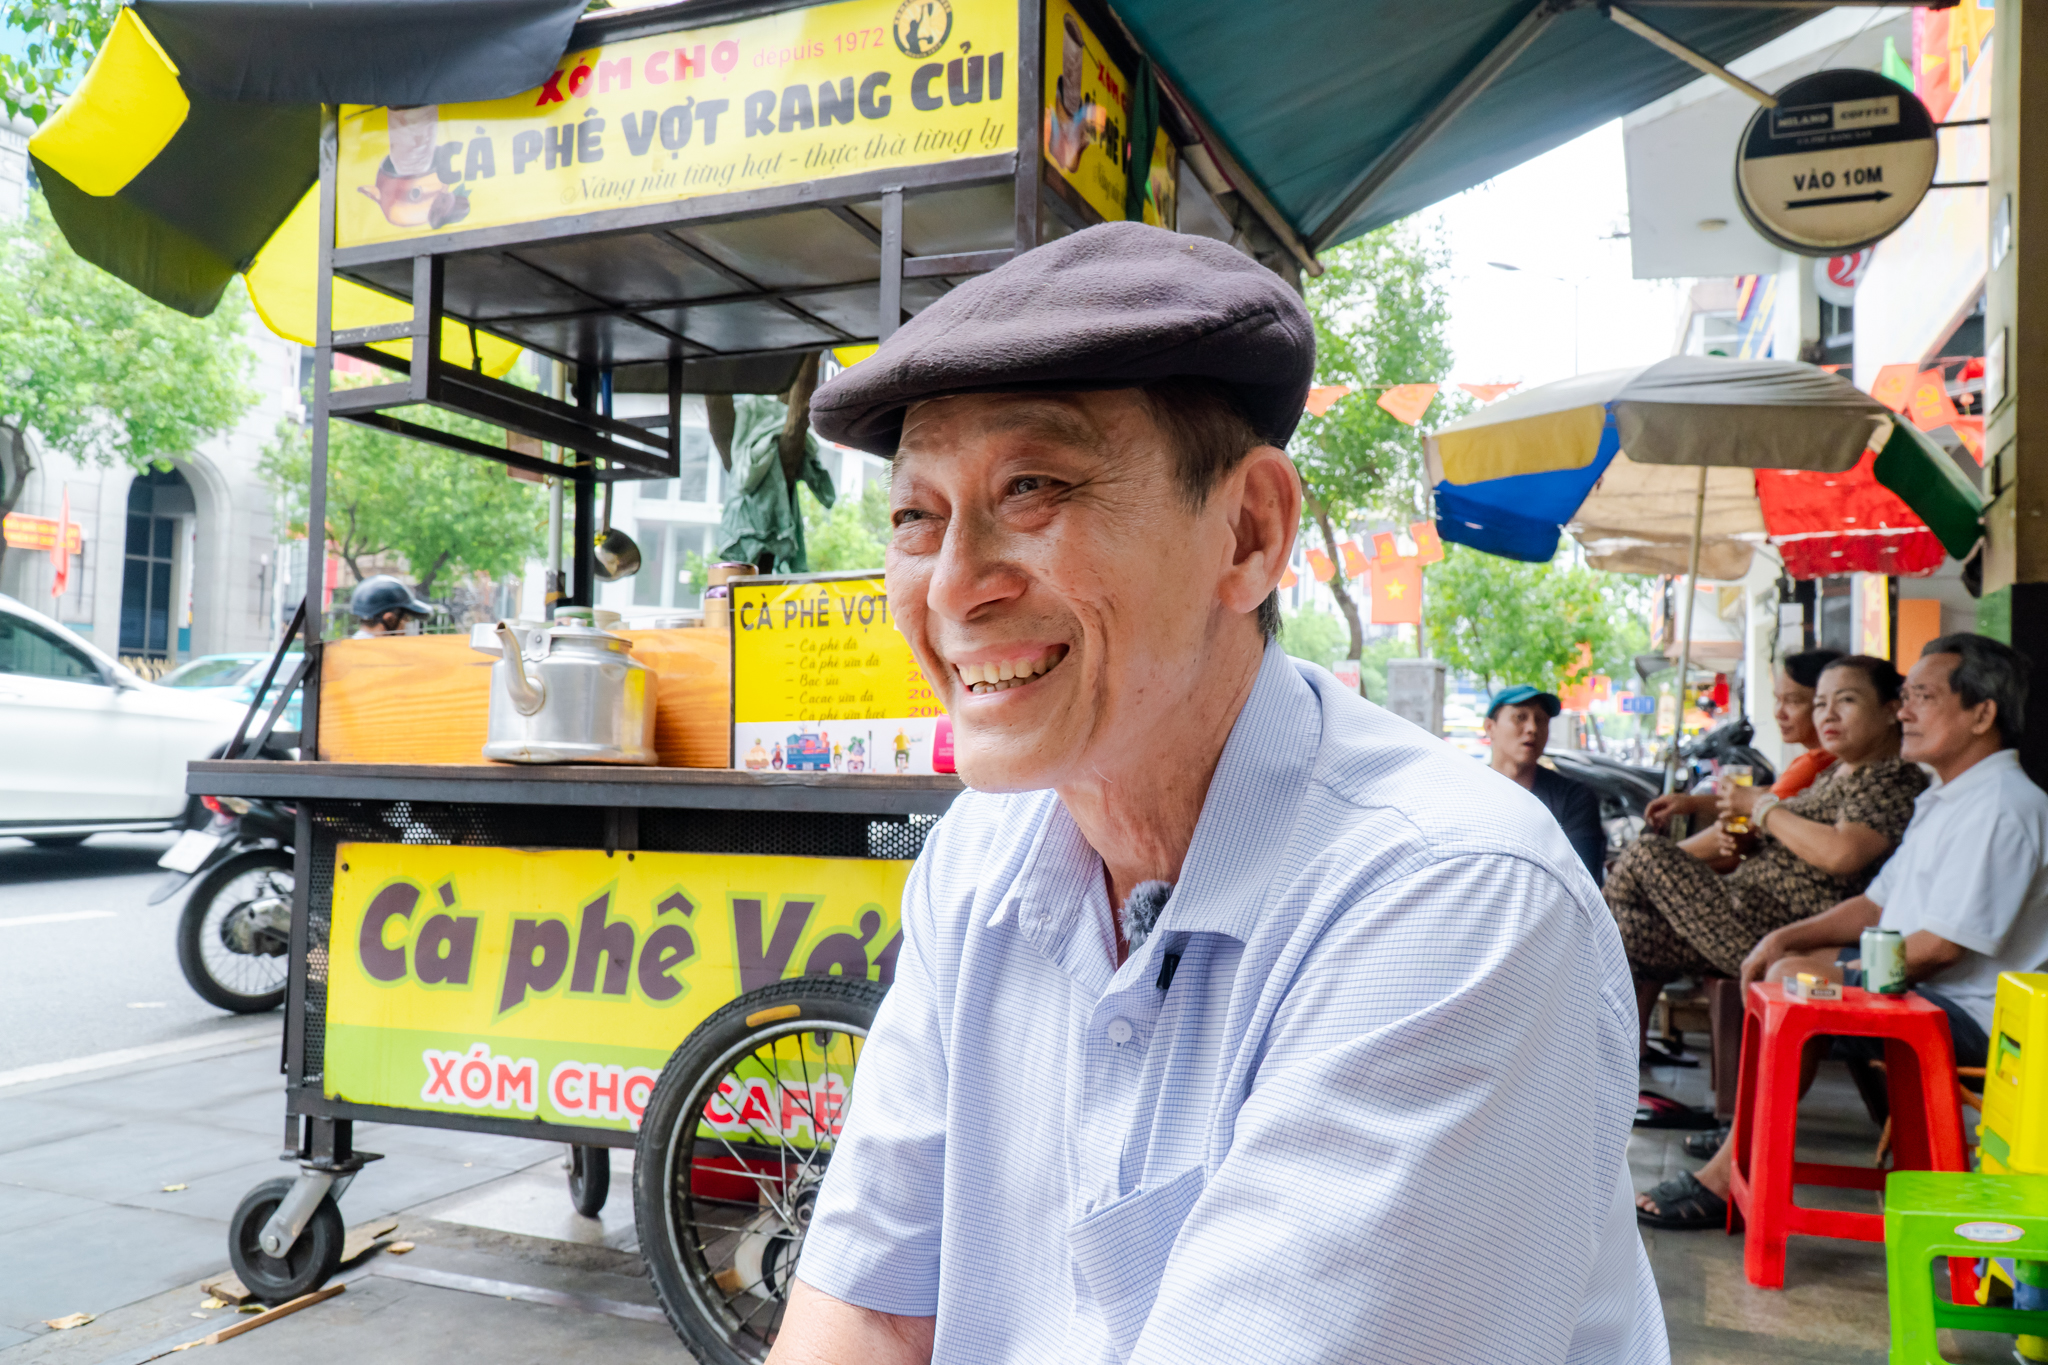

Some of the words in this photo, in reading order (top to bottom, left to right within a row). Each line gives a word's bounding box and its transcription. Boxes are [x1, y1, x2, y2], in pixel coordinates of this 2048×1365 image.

[535, 56, 632, 107] XÓM
[644, 38, 741, 85] CHỢ
[753, 38, 825, 68] dépuis
[834, 27, 885, 54] 1972
[435, 125, 496, 185] CÀ
[512, 107, 606, 175] PHÊ
[621, 95, 730, 160] VỢT
[744, 71, 892, 138] RANG
[910, 40, 1004, 112] CỦI
[640, 168, 678, 193] niu
[741, 149, 784, 180] hạt
[979, 117, 1005, 150] ly
[1793, 167, 1835, 191] VÀO
[1842, 166, 1883, 186] 10M
[740, 593, 773, 631] CÀ
[784, 589, 830, 629] PHÊ
[840, 594, 887, 633] VỢT
[358, 881, 479, 985] Cà
[498, 890, 697, 1016] phê
[427, 1050, 534, 1109] XÓM
[703, 1081, 843, 1135] CAFÉ
